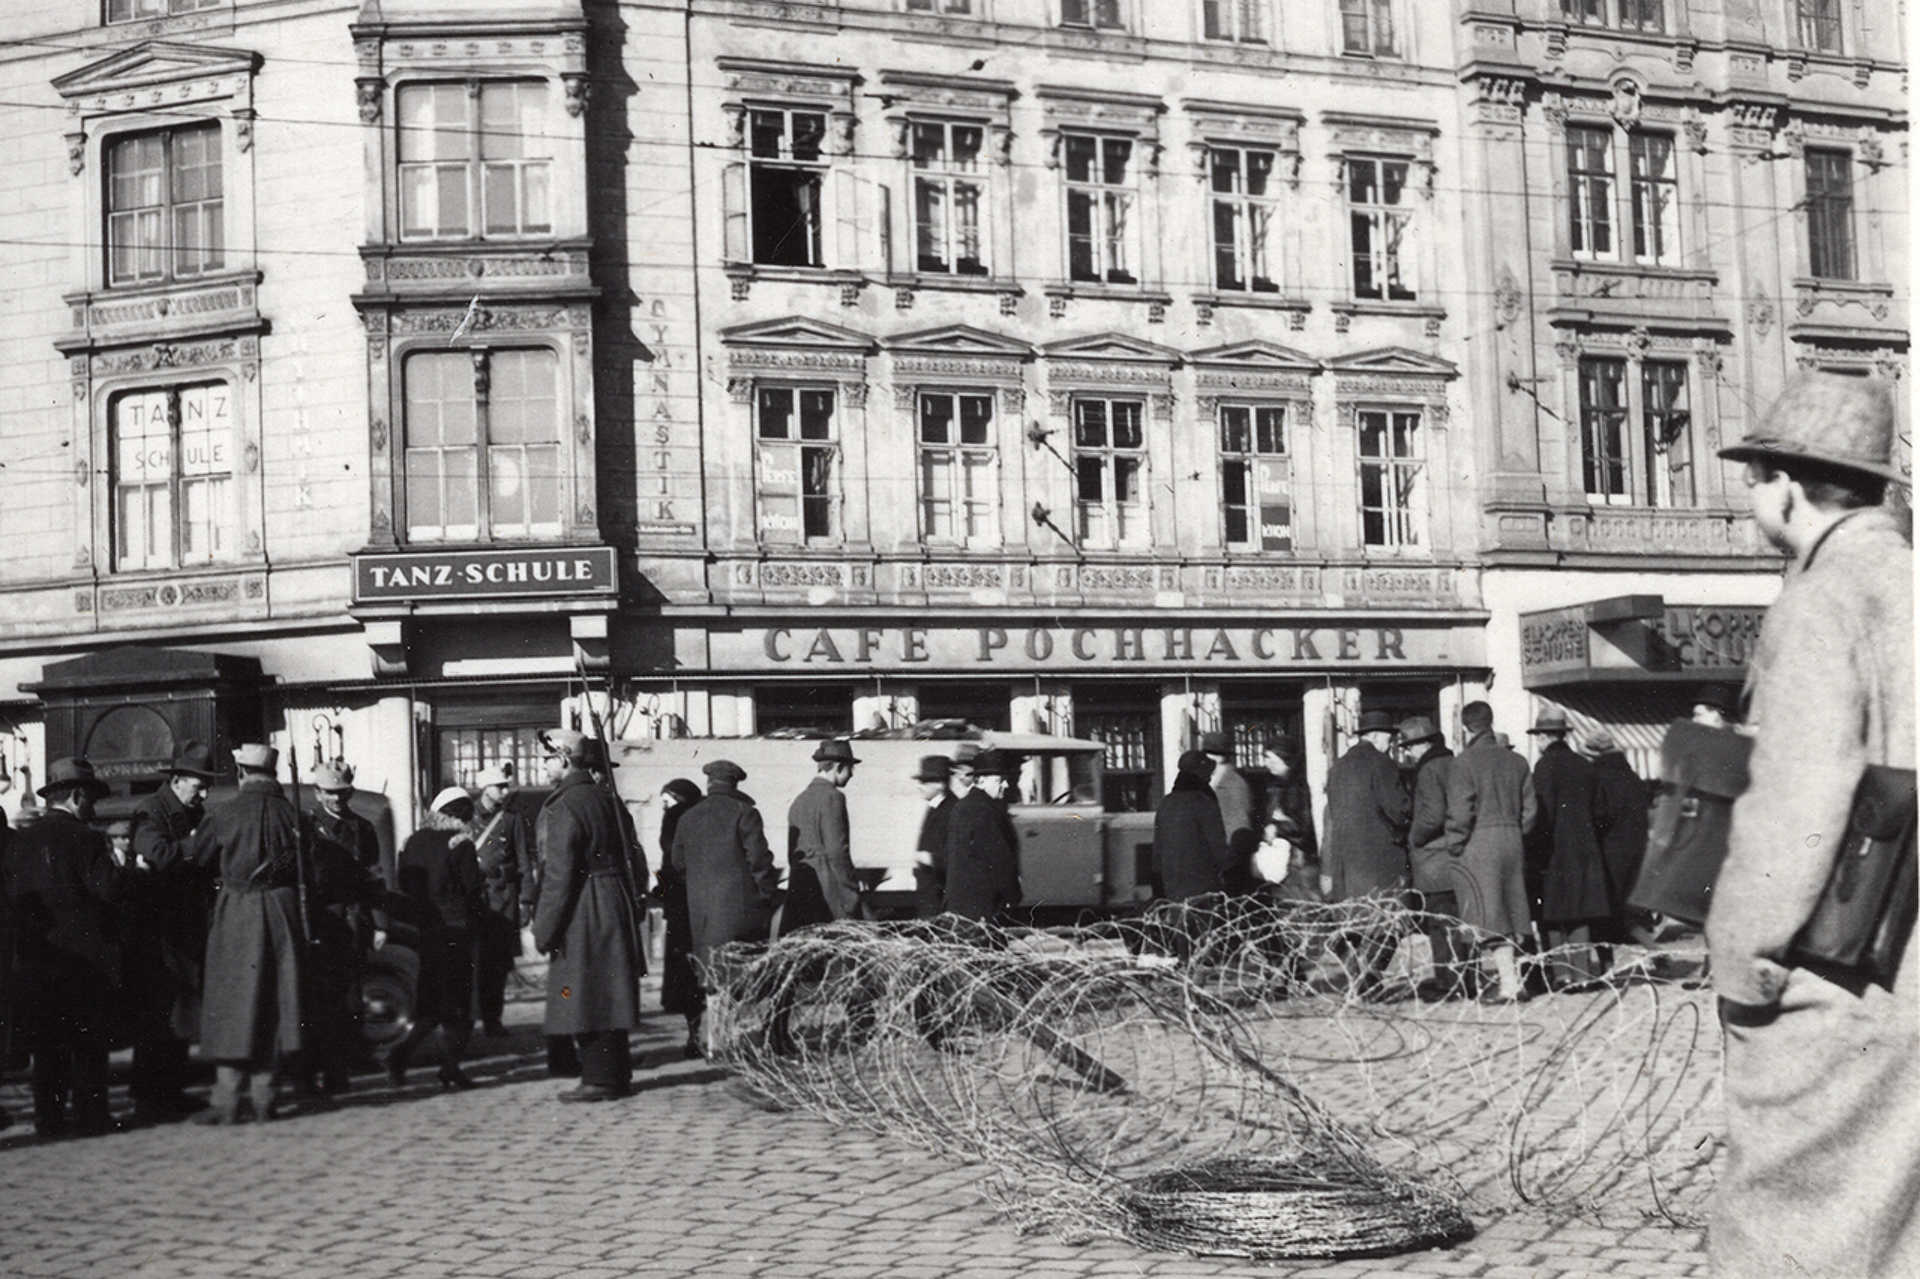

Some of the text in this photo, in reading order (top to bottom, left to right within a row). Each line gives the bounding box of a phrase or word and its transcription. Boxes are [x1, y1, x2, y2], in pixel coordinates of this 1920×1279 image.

[129, 396, 228, 426] TANZ
[135, 444, 224, 470] SCHULE
[763, 627, 1408, 662] CAFE POCHHACKER
